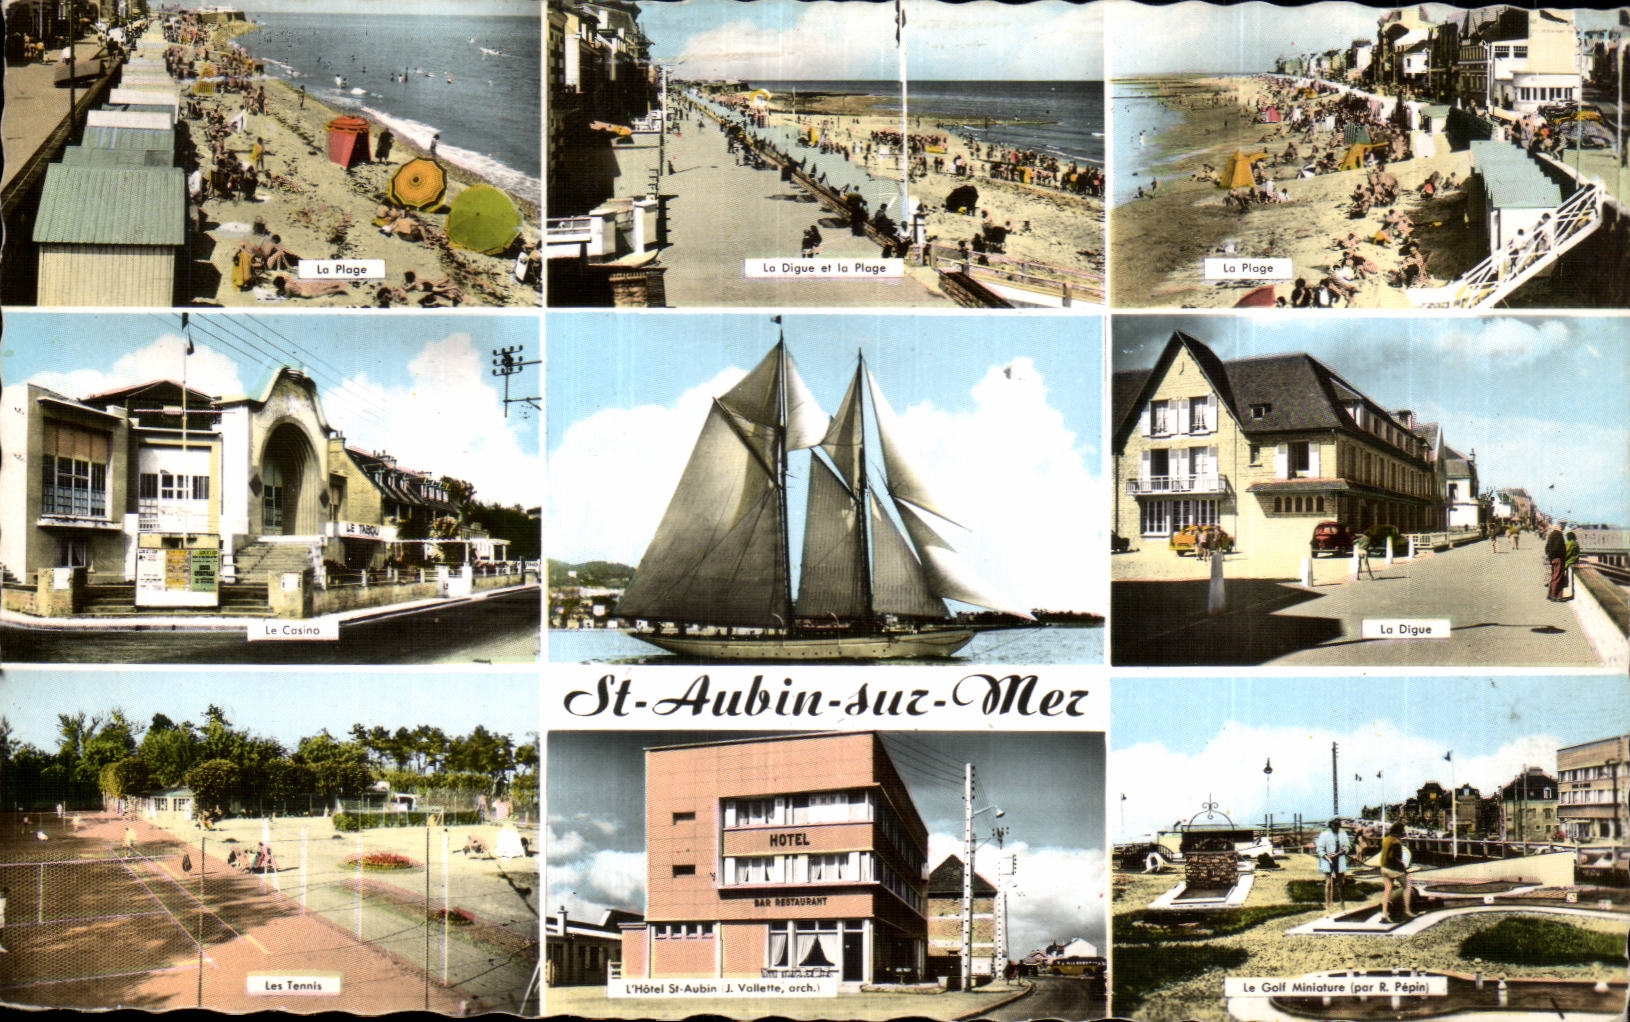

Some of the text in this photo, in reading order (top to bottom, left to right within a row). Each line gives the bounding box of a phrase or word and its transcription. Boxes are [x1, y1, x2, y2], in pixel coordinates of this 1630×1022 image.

[346, 523, 355, 533] LE
[769, 833, 810, 847] HOTEL
[754, 897, 827, 907] BAR RESTAURANT
